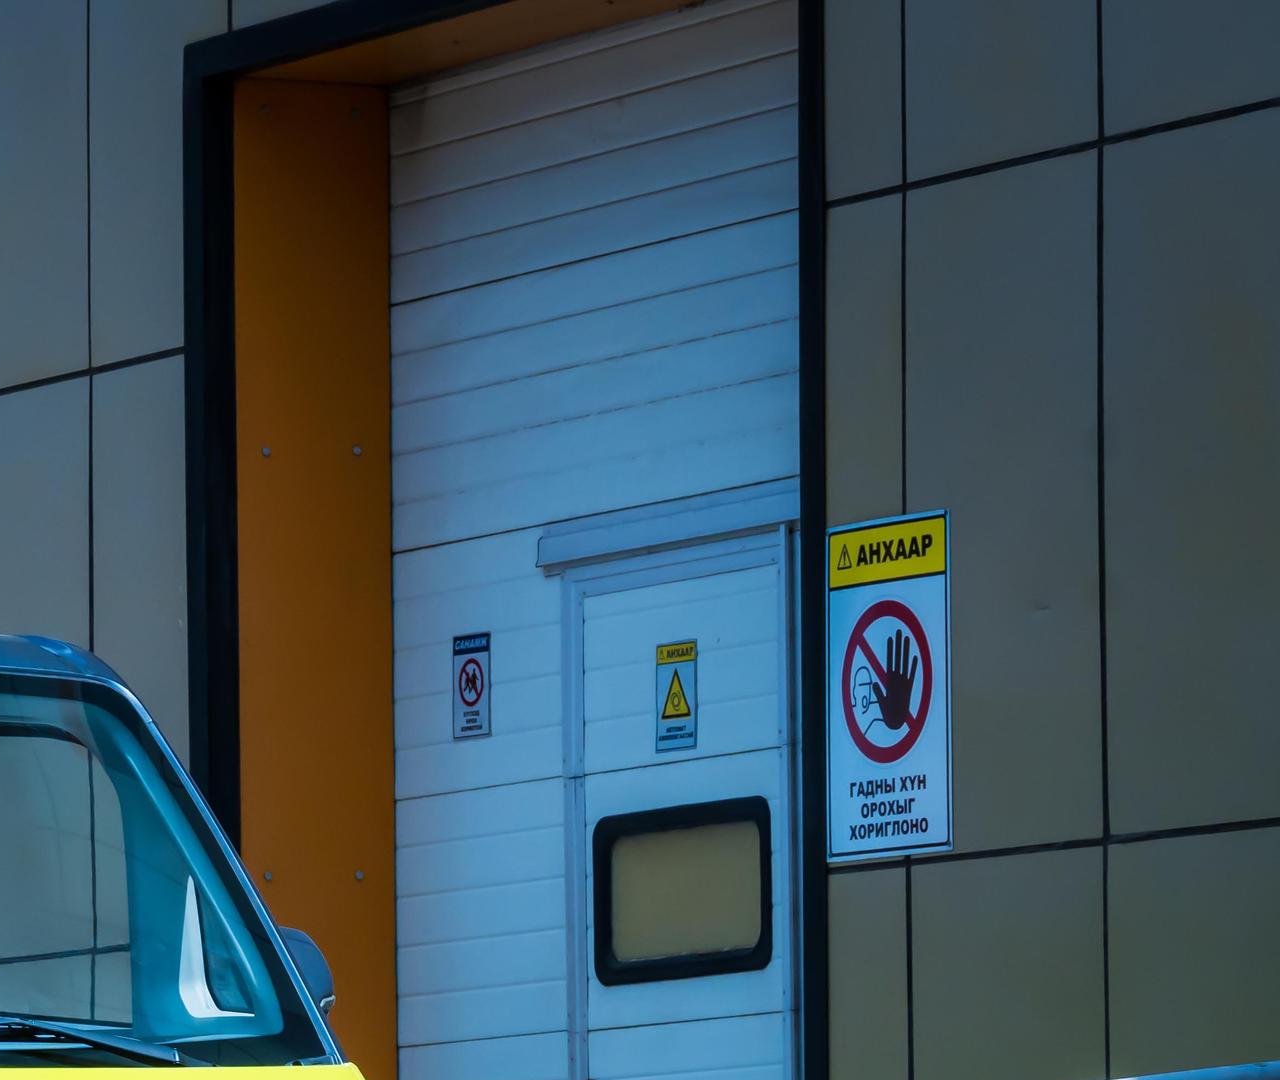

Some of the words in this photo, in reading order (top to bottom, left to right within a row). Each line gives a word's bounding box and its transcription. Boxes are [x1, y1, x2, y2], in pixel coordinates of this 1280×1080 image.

[856, 533, 934, 567] АНХААР
[666, 646, 695, 659] АНХААР
[849, 777, 897, 799] ГАДНЫ
[899, 774, 927, 793] ХҮН
[860, 797, 916, 819] ОРОХЫГ
[849, 816, 929, 841] ХОРИГЛОНО
